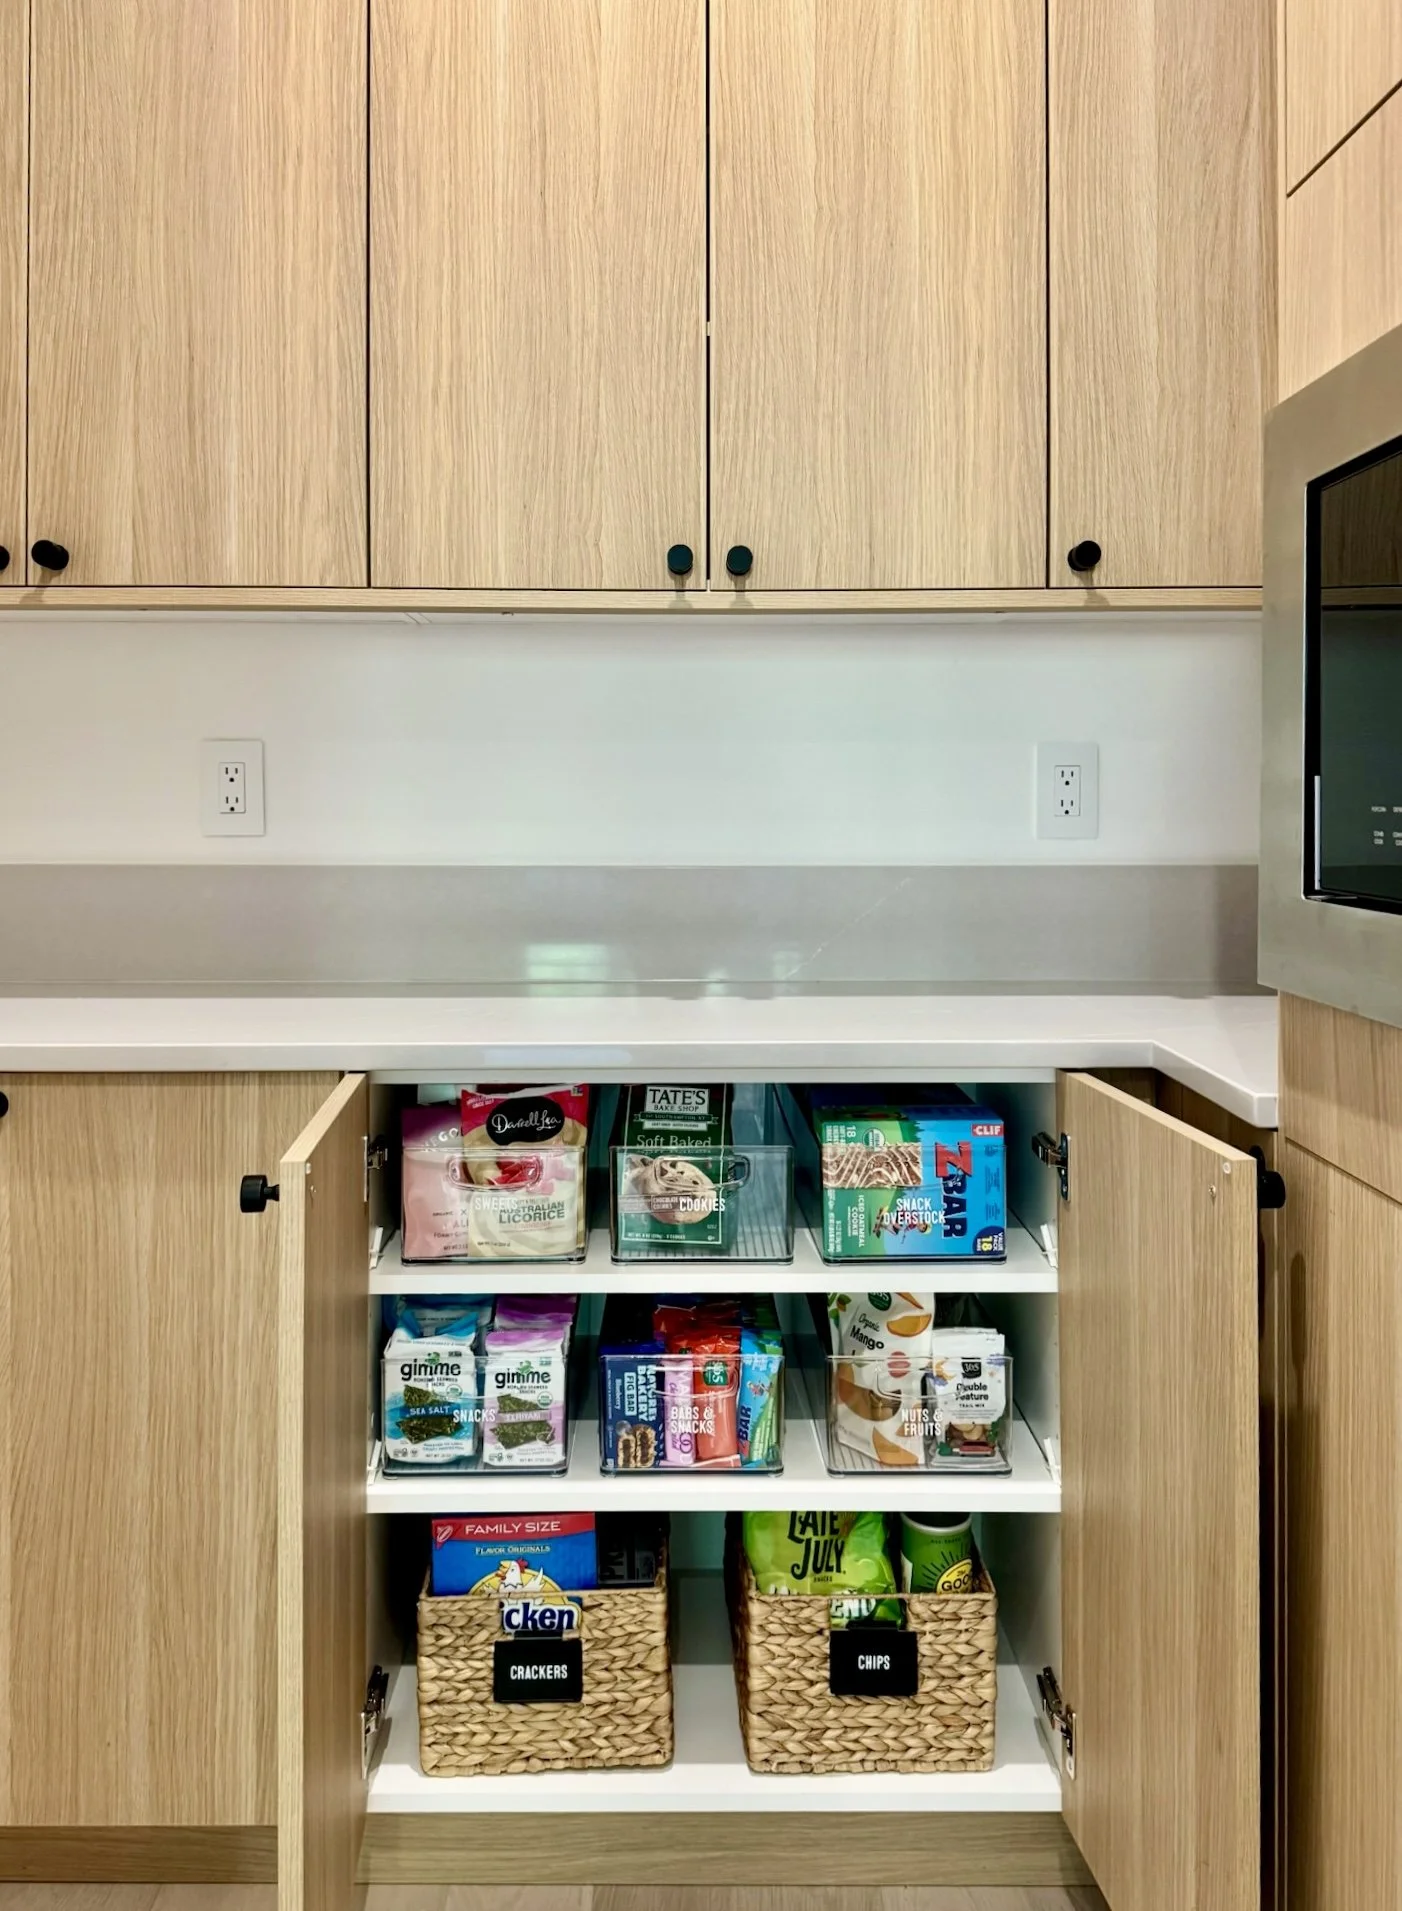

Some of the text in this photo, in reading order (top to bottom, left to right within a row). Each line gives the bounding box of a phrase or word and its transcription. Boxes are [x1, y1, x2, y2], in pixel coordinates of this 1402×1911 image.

[648, 1088, 706, 1106] TATE'S
[653, 1104, 674, 1112] BAKE
[846, 1125, 857, 1138] 18
[975, 1125, 1001, 1136] CLIF
[636, 1135, 712, 1148] Soft Baked
[474, 1196, 518, 1211] SWEETS
[499, 1201, 565, 1215] AUSTRALIAN
[679, 1197, 727, 1212] COOKIES
[896, 1198, 932, 1211] SNACK
[498, 1208, 566, 1224] LICORICE
[851, 1206, 859, 1237] COOKIE
[883, 1210, 947, 1225] OVERSTOCK
[857, 1213, 865, 1248] OATMEAL
[981, 1235, 993, 1252] 18
[858, 1312, 880, 1333] Organic
[849, 1324, 885, 1351] Mango
[400, 1358, 462, 1382] gimme
[494, 1367, 551, 1389] gimme
[626, 1375, 635, 1412] FIG BAR
[637, 1364, 648, 1421] BAKERY
[956, 1381, 988, 1392] Double
[410, 1405, 451, 1416] SEA SALT
[453, 1408, 496, 1423] SNACKS
[670, 1406, 714, 1420] BARS &
[901, 1408, 929, 1422] NUTS
[933, 1408, 944, 1422] &
[670, 1421, 714, 1435] SNACKS
[904, 1422, 942, 1436] FRUITS
[464, 1520, 561, 1536] FAMILY SIZE
[787, 1511, 841, 1544] LATE
[500, 1602, 575, 1631] cken
[857, 1654, 891, 1671] CHIPS
[509, 1664, 569, 1681] CRACKERS
